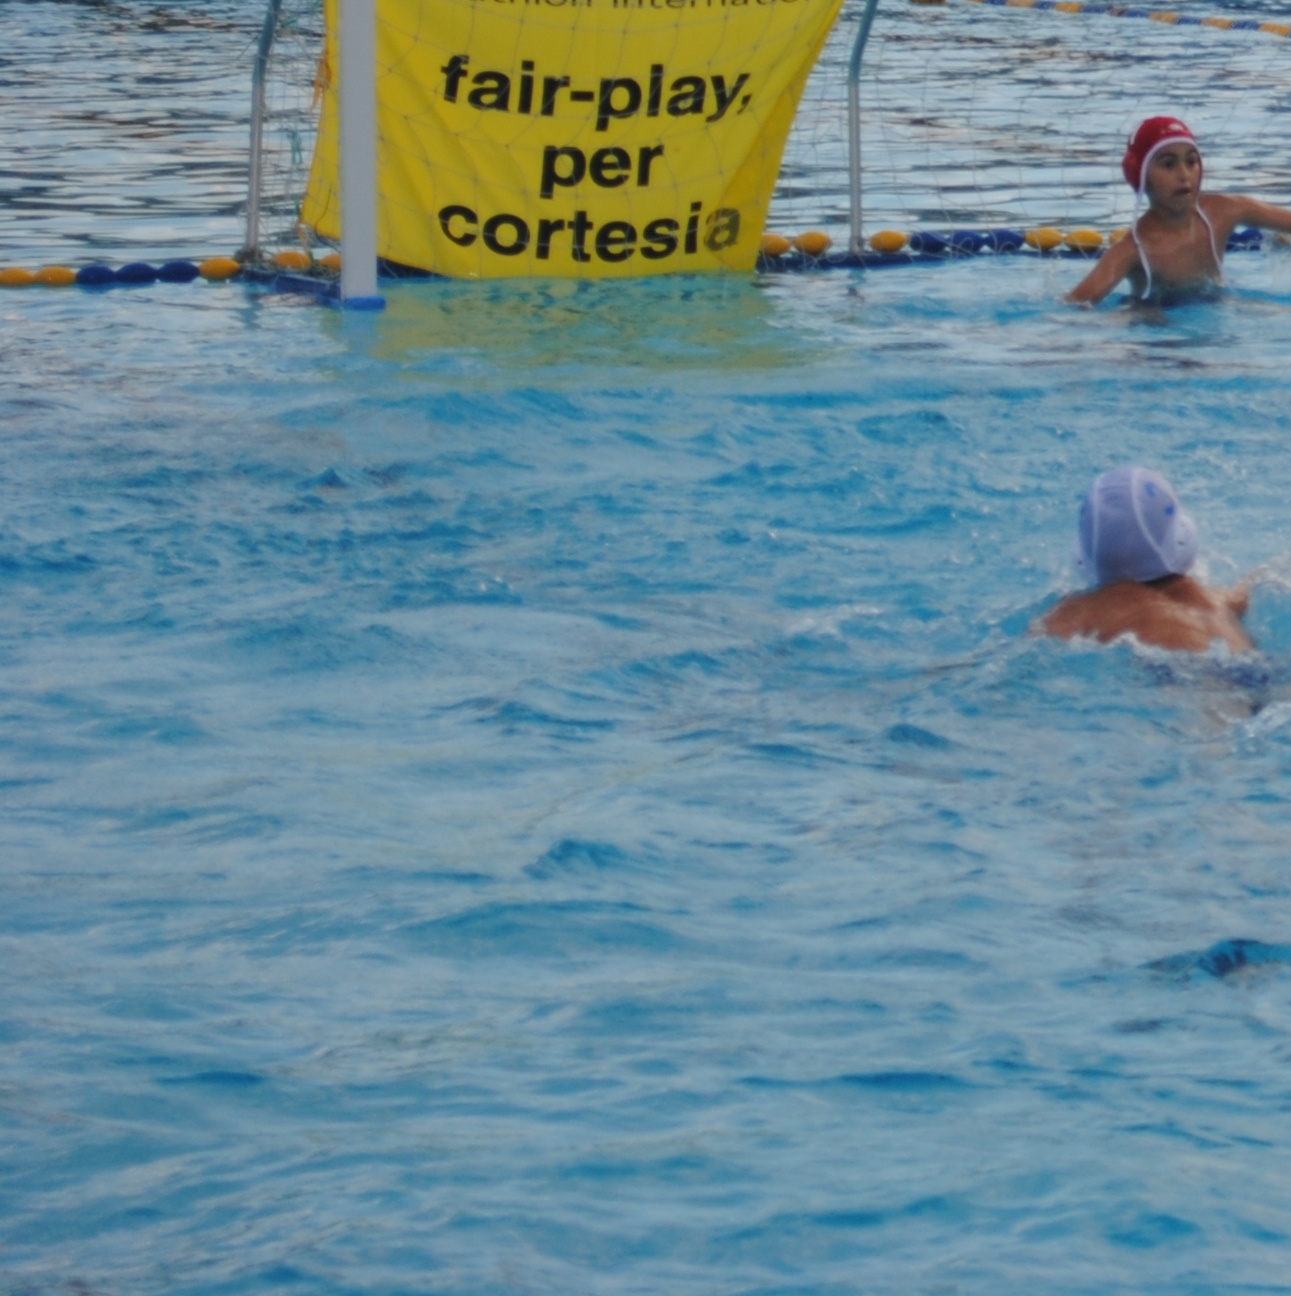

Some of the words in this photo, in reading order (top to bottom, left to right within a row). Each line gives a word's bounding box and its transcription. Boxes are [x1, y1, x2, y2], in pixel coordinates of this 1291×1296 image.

[440, 54, 753, 133] fair-play,
[540, 143, 665, 200] per
[438, 201, 741, 263] cortesia
